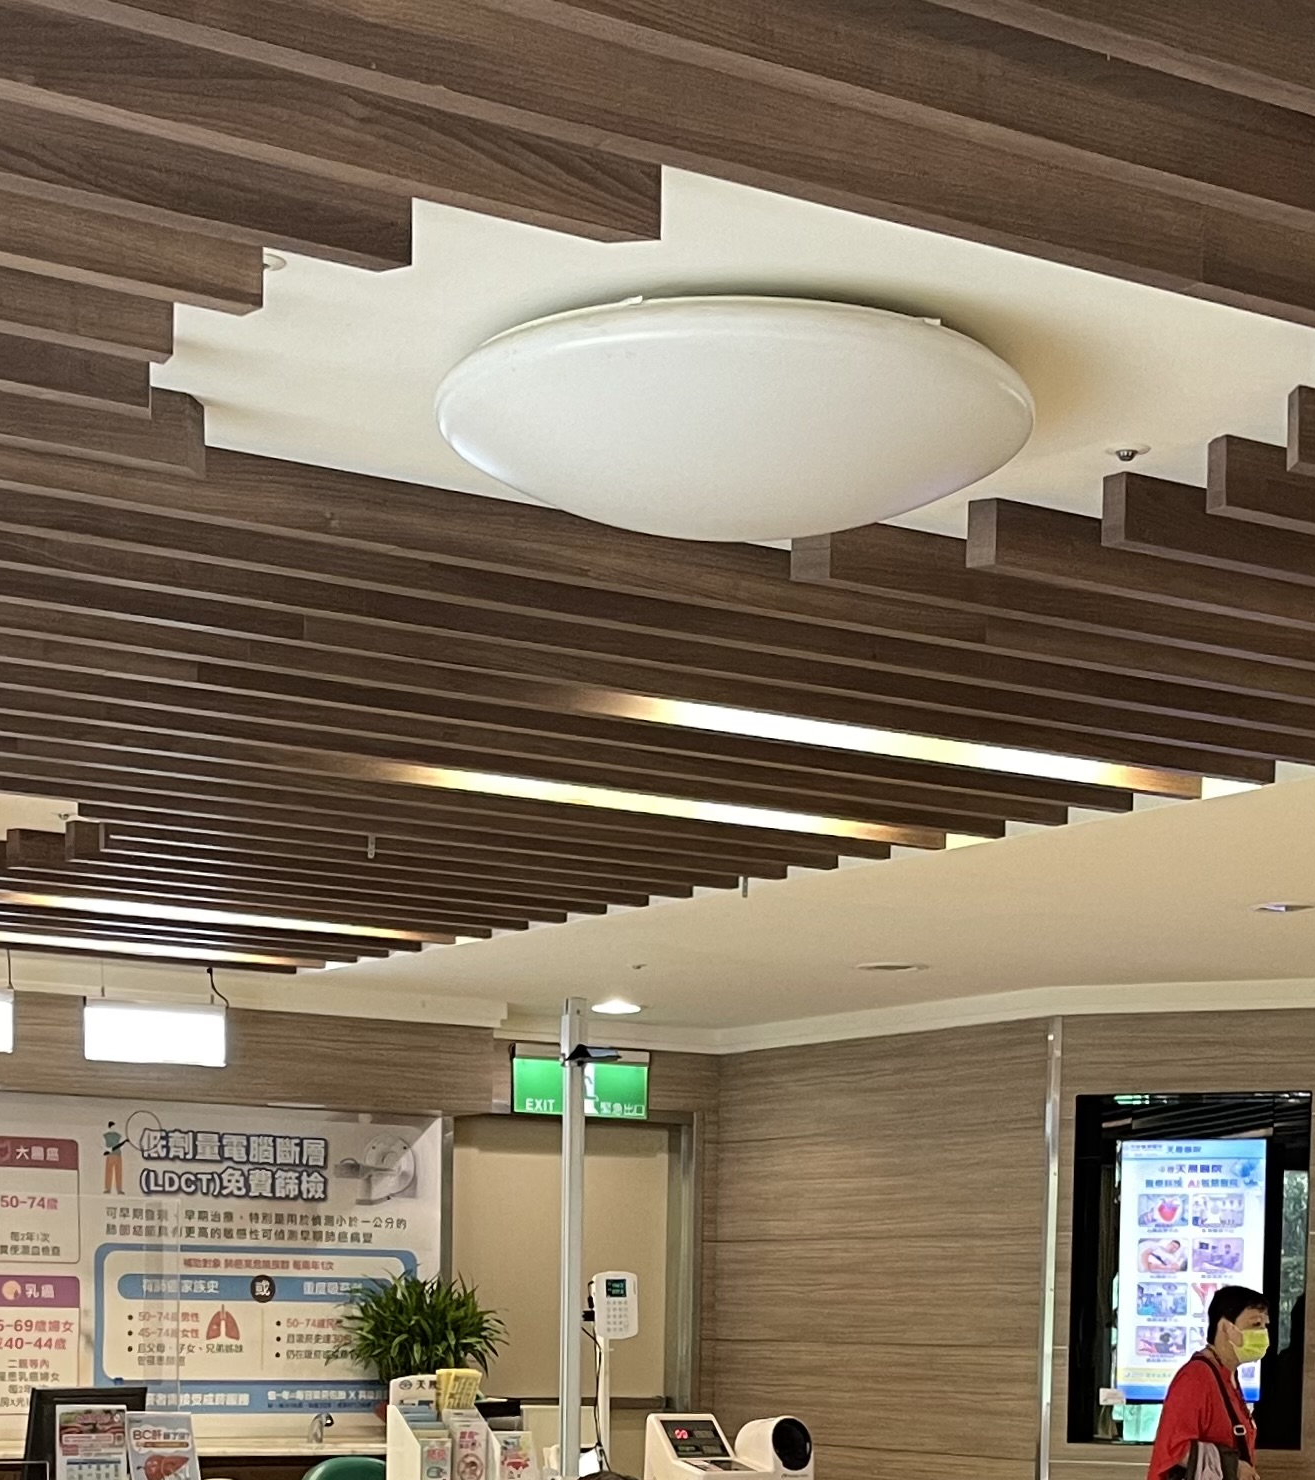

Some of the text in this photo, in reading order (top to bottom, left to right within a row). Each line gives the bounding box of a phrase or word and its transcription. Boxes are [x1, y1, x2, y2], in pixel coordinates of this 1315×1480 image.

[525, 1098, 555, 1112] EXIT
[140, 1127, 328, 1168] 低劑量電腦斷層
[139, 1166, 328, 1202] (LDCT)免費篩檢
[0, 1194, 59, 1211] 50-74歲
[25, 1283, 55, 1299] 乳癌
[254, 1279, 271, 1296] 或
